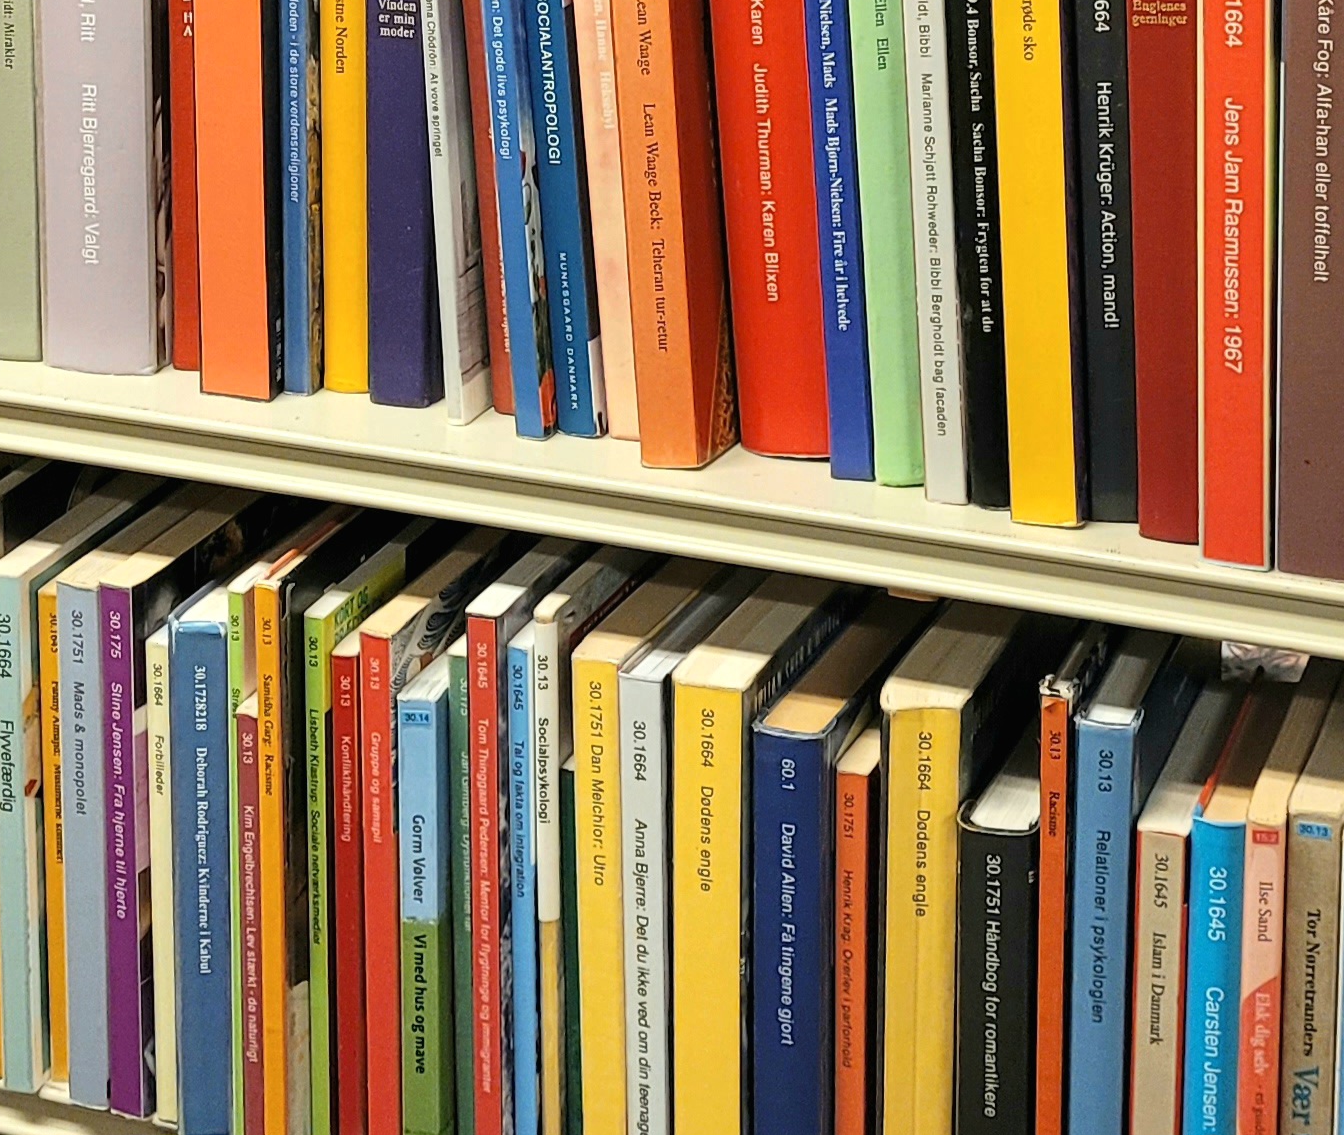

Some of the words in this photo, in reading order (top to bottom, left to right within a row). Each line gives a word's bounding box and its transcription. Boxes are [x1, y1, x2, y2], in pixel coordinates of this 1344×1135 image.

[1020, 0, 1037, 32] røde
[1022, 35, 1038, 61] sko
[1312, 39, 1334, 78] Fog:
[1224, 97, 1243, 146] Jens
[1315, 83, 1333, 157] Alfa-han
[1224, 149, 1243, 193] Jam
[1314, 162, 1331, 201] eller
[1224, 198, 1243, 319] Rasmussen:
[559, 252, 573, 342] MUNKSGAARD
[566, 347, 578, 410] DANMARK
[1223, 325, 1243, 374] 1967
[536, 654, 549, 691] 30.13
[700, 707, 715, 768] 30.1664
[536, 717, 551, 824] Socialpsykologi
[781, 758, 796, 790] 60.1
[1097, 748, 1114, 793] 30.13
[699, 785, 714, 845] Dødens
[780, 822, 796, 869] David
[696, 848, 713, 892] engle
[1093, 829, 1112, 912] Relationer
[781, 871, 796, 918] Allen:
[413, 933, 427, 949] Vi
[781, 922, 796, 943] Få
[413, 951, 428, 984] med
[777, 946, 795, 1006] tingene
[1088, 924, 1107, 1024] psykologien
[414, 986, 428, 1012] hus
[411, 1014, 425, 1034] og
[777, 1007, 794, 1045] gjort
[414, 1035, 425, 1074] mave
